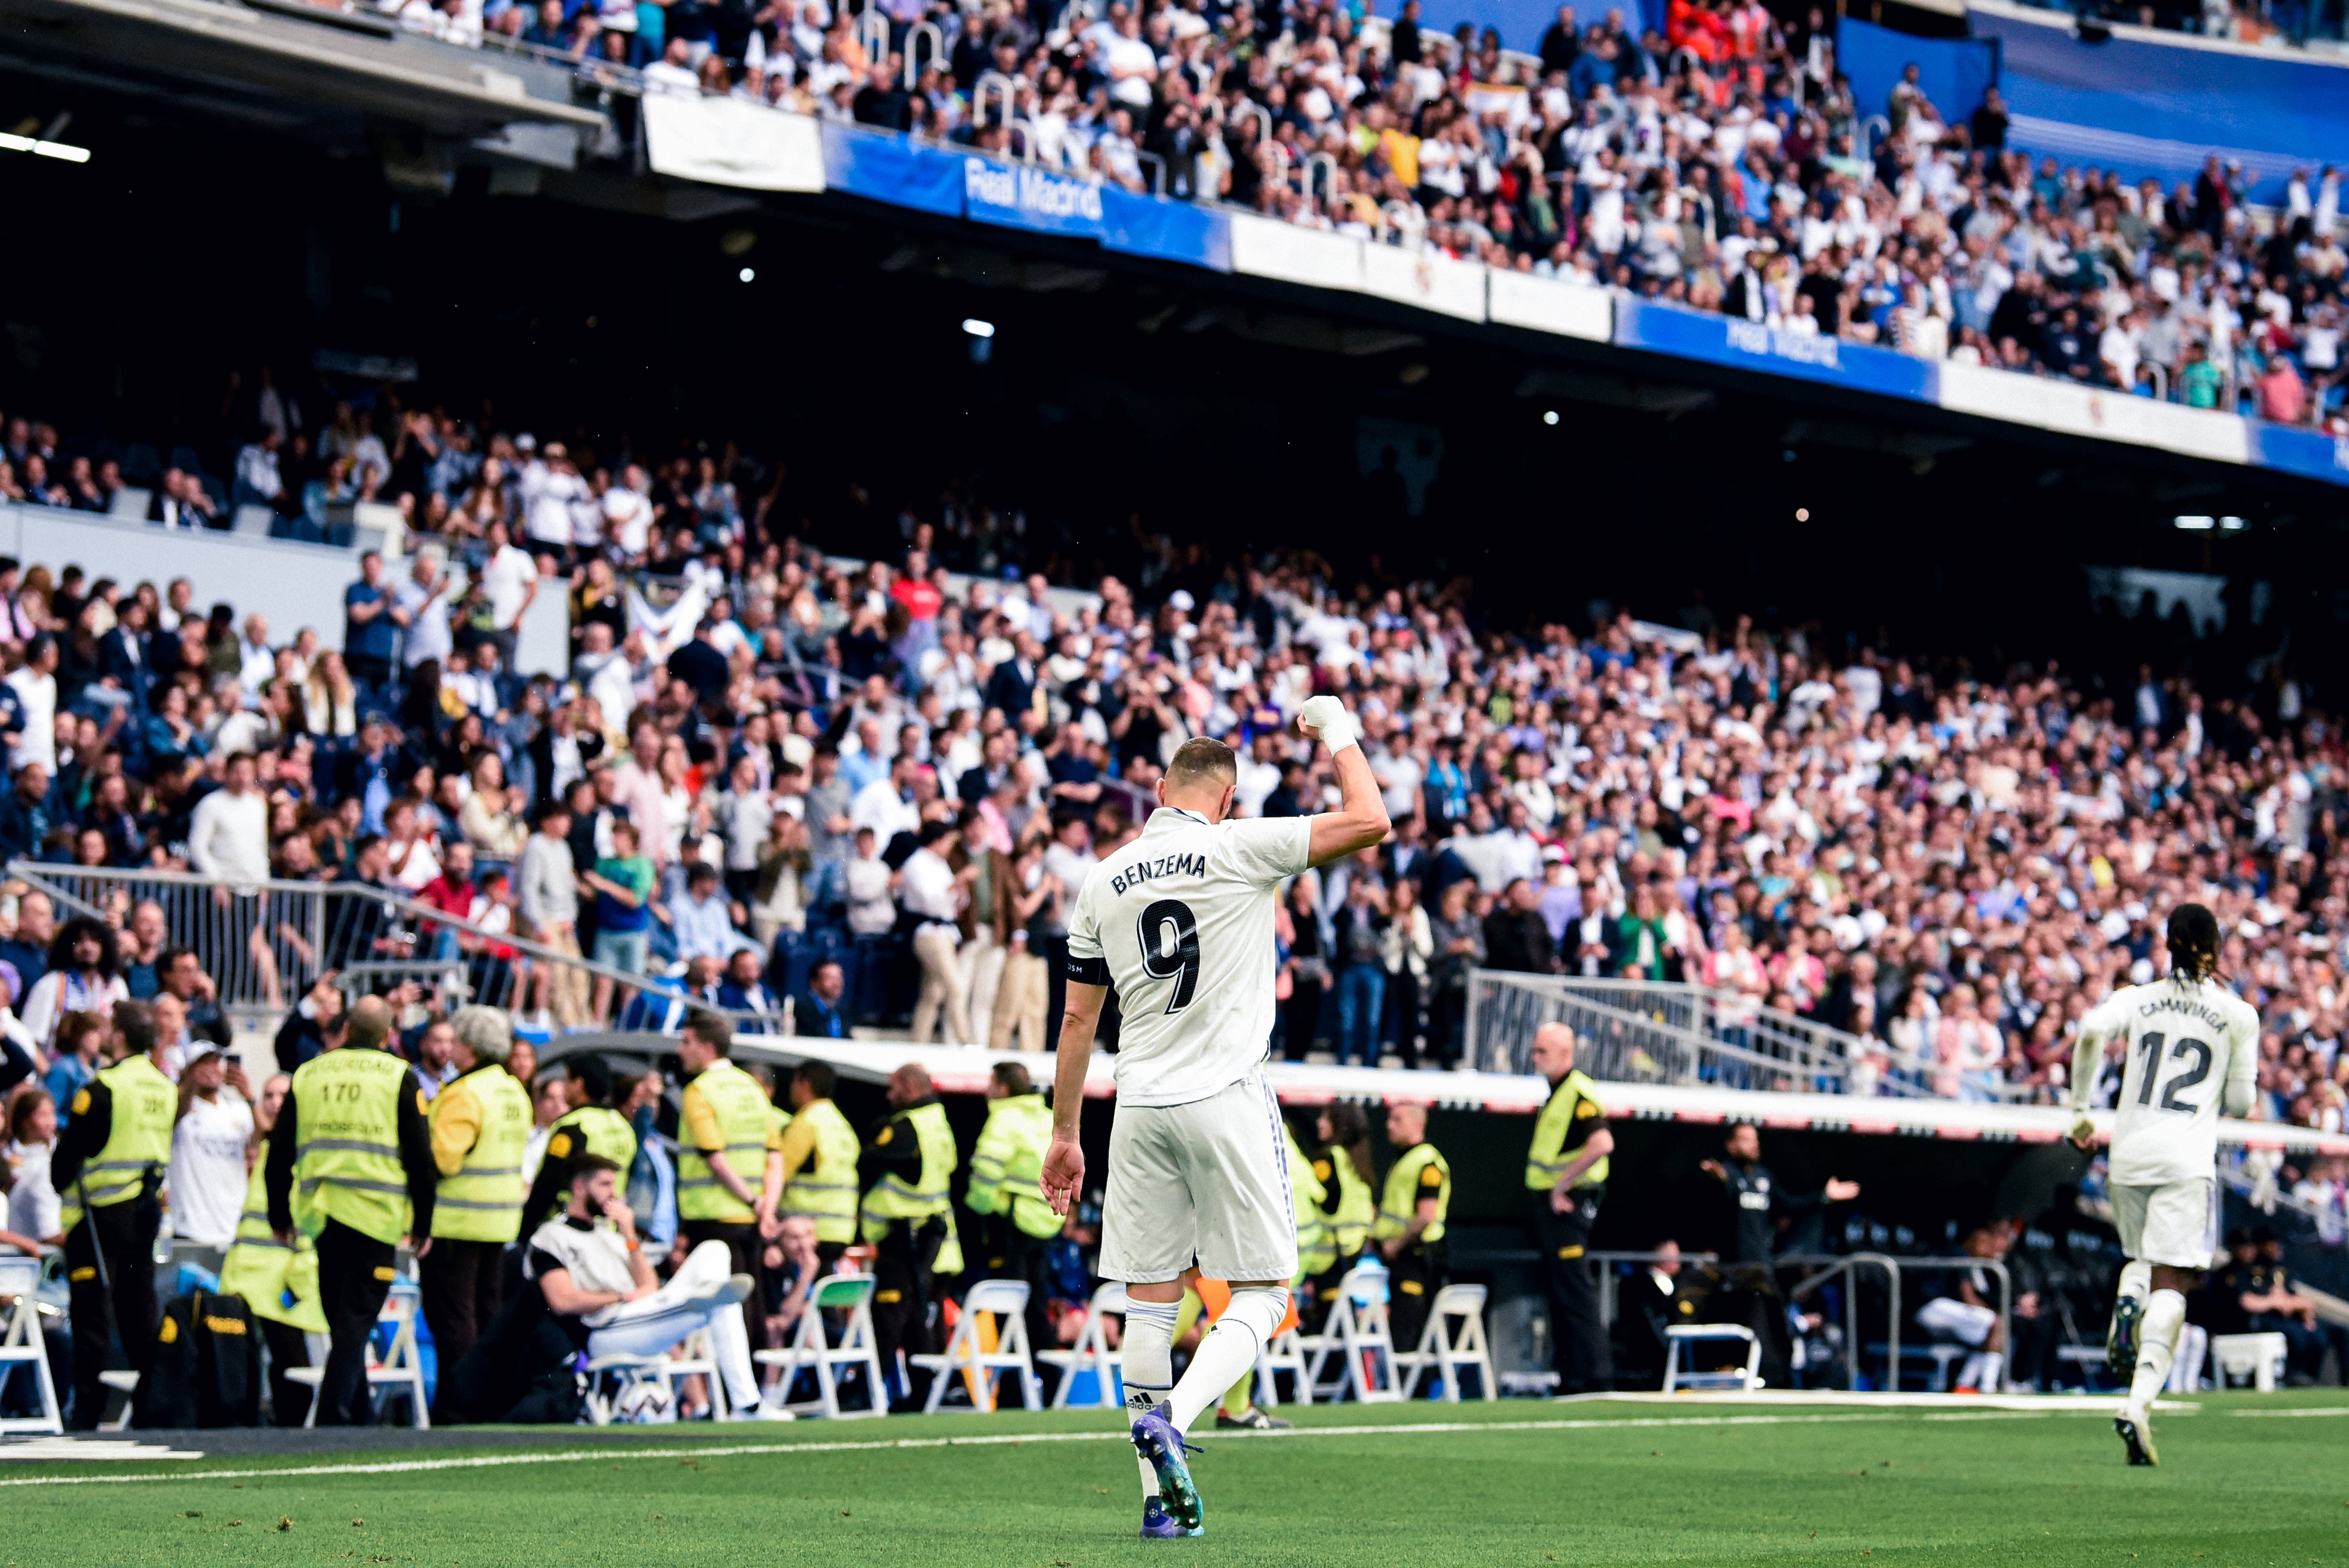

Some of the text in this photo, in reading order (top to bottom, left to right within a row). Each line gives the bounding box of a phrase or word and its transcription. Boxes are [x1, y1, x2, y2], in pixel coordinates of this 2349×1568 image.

[1111, 853, 1206, 897] BENZEMA
[1136, 899, 1200, 1015] 9
[2139, 998, 2228, 1034] CAMAVINGA
[322, 1082, 361, 1103] 170
[2138, 1031, 2211, 1114] 12
